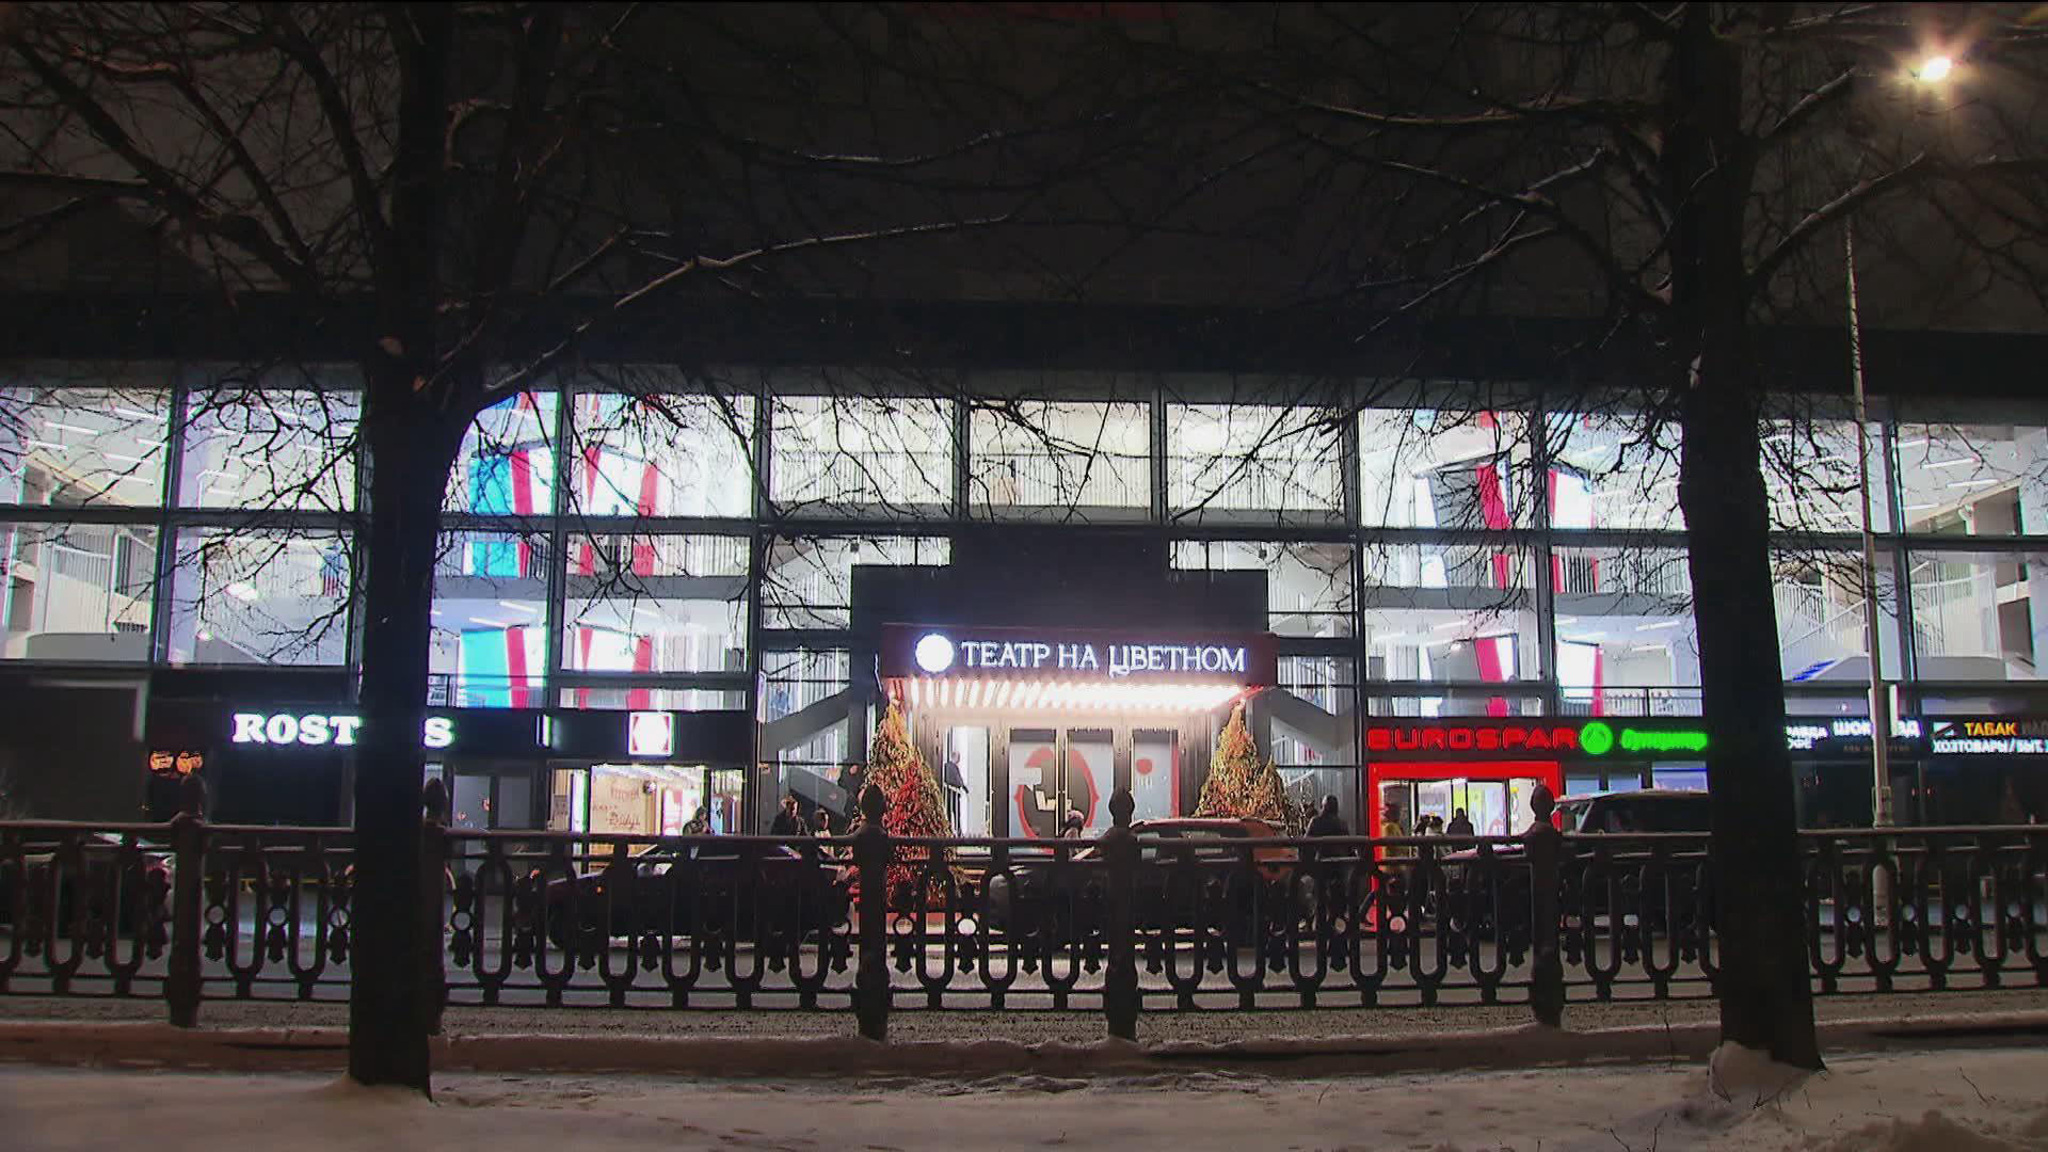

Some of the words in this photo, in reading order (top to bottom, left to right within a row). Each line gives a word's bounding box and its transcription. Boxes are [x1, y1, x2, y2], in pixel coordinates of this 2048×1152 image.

[961, 641, 1050, 668] ТЕАТР
[1057, 643, 1100, 669] НА
[1108, 645, 1246, 678] ЦВЕТНОМ
[1964, 722, 2017, 736] ТАБАК
[1367, 727, 1578, 750] EUROSPAR
[1932, 739, 2008, 753] ХОЗТОВАРЫ
